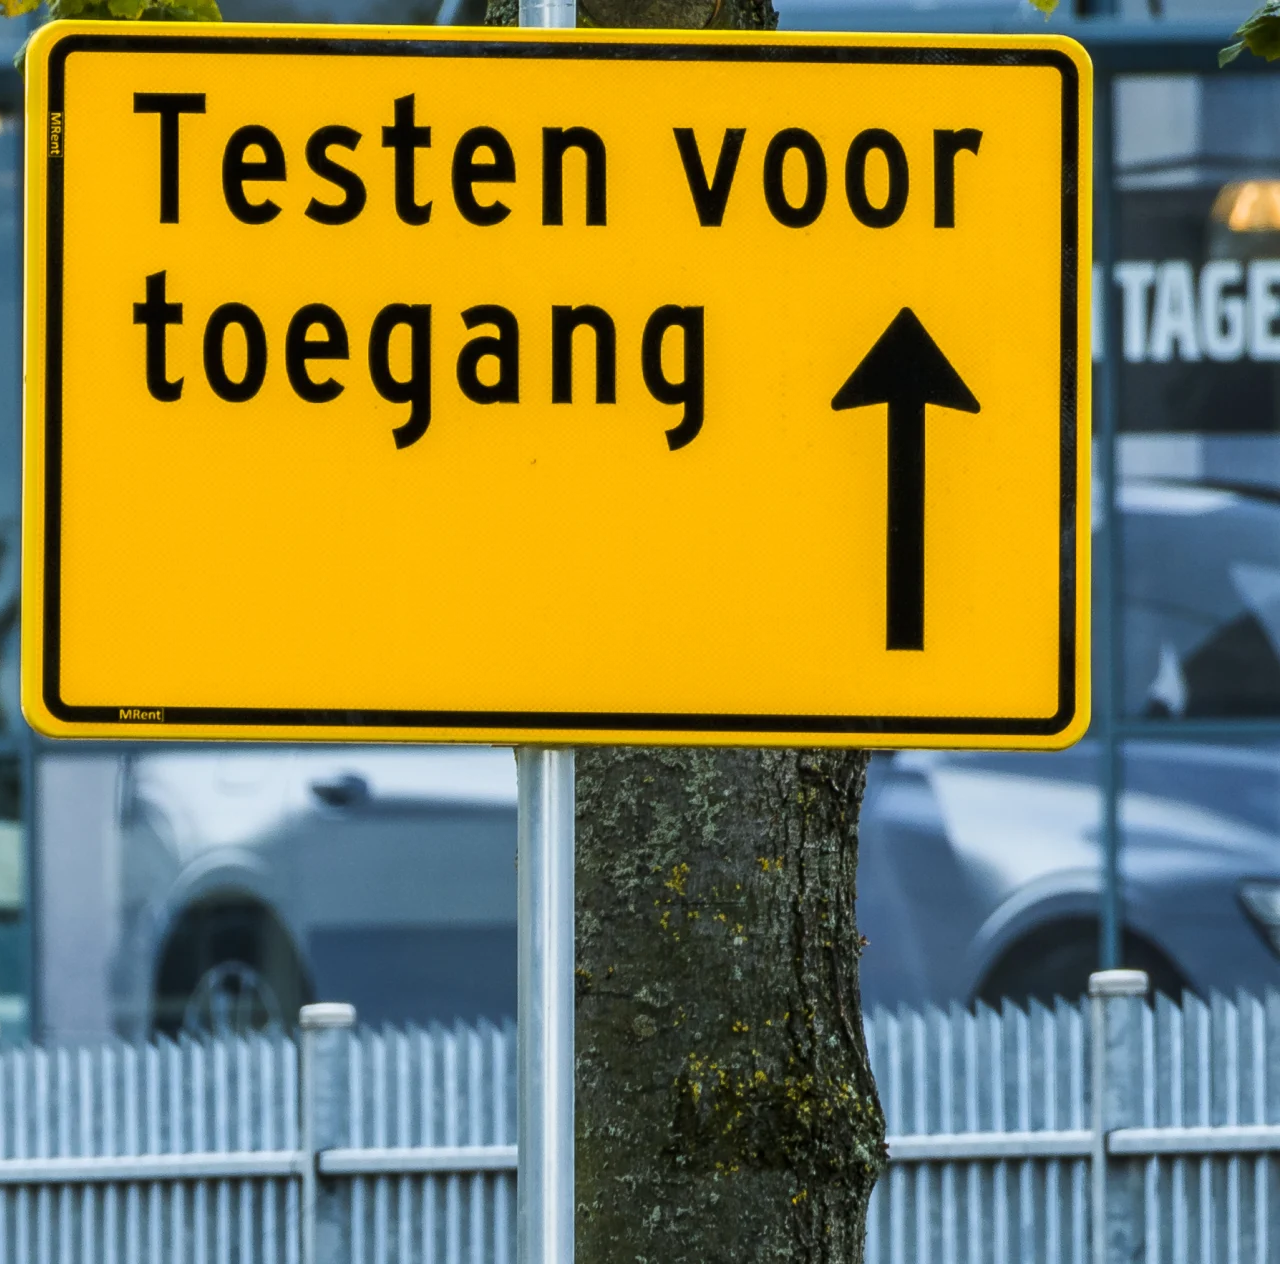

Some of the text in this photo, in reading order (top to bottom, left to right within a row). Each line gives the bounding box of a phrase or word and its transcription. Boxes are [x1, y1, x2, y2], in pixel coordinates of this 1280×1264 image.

[49, 111, 62, 156] MRent
[133, 92, 985, 229] Testen voor
[132, 269, 706, 452] toegang
[118, 708, 162, 721] MRent
